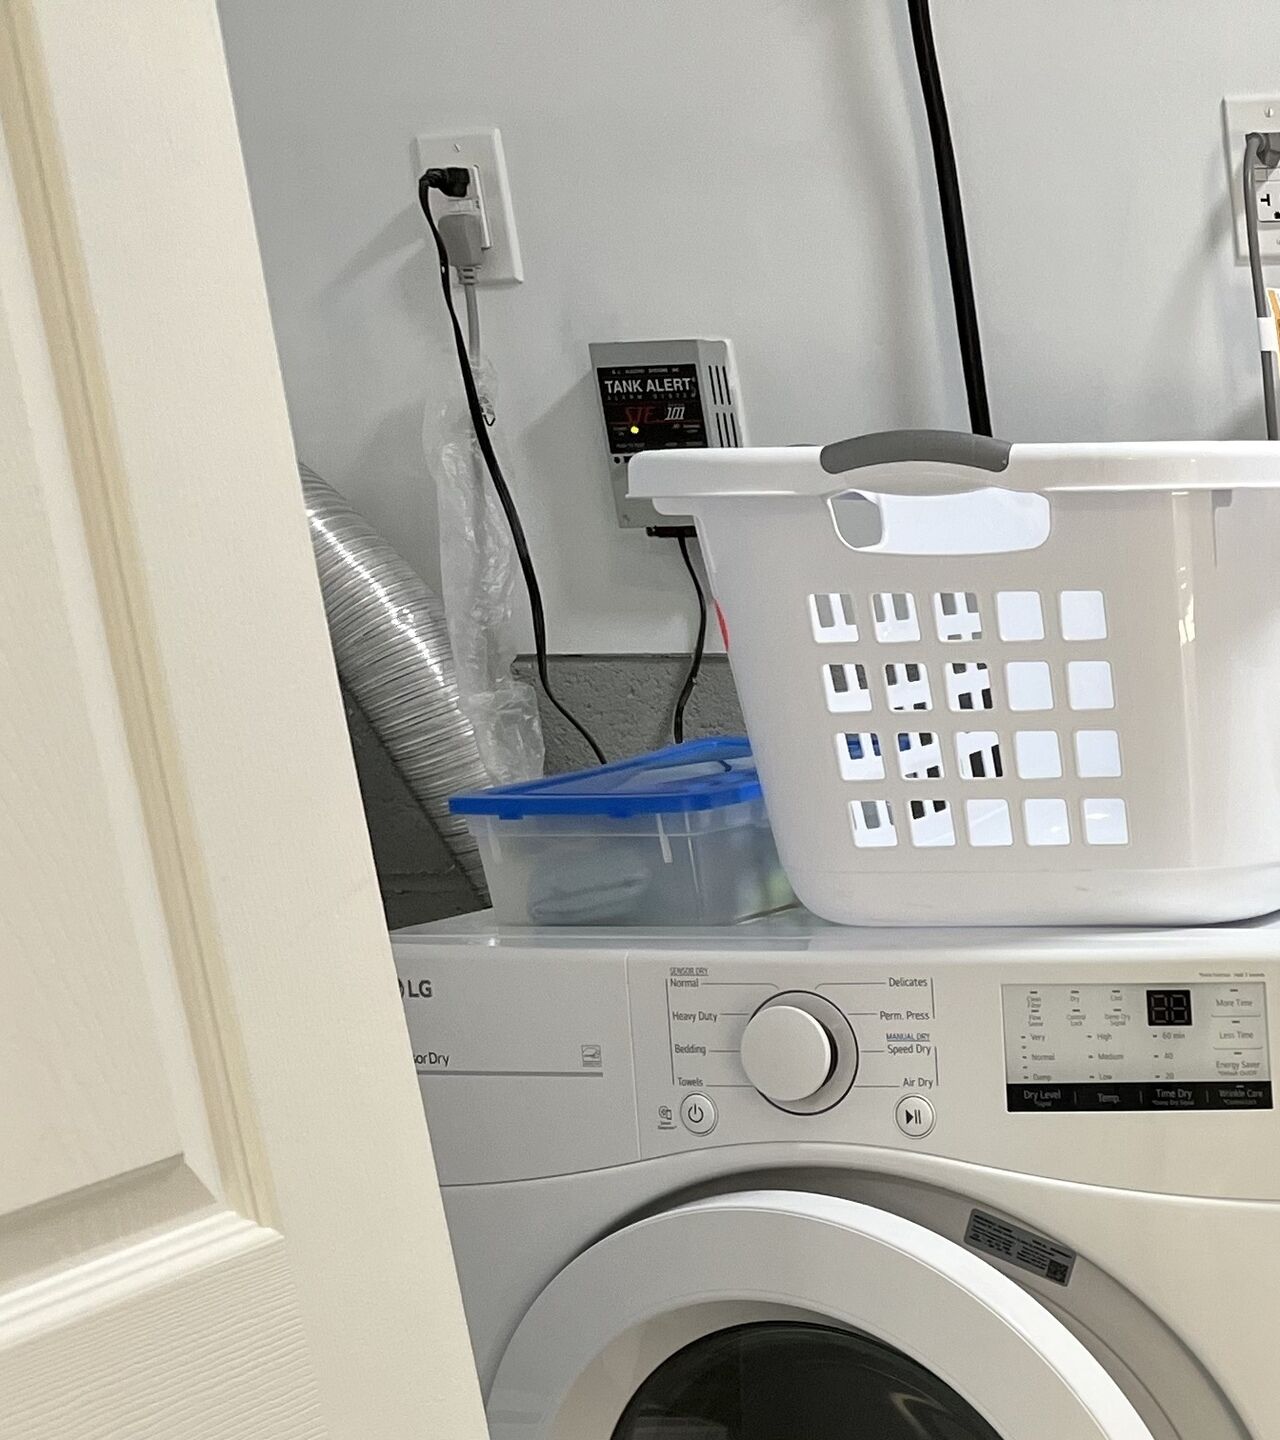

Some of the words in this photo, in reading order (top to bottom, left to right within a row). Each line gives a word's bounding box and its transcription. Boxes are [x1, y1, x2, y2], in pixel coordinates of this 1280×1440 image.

[604, 380, 643, 394] TANK
[646, 378, 691, 392] ALERT
[670, 978, 699, 988] Normal
[888, 977, 928, 987] Delicates
[408, 980, 433, 998] LG
[1216, 999, 1234, 1007] More
[1236, 998, 1253, 1007] Time
[672, 1011, 697, 1023] Heavy
[698, 1011, 718, 1023] Duty
[880, 1010, 904, 1021] Perm.
[906, 1010, 930, 1021] Press
[886, 1033, 915, 1041] MANUAL
[916, 1033, 931, 1041] DRY
[1162, 1032, 1172, 1040] 60
[1237, 1031, 1254, 1039] Time
[674, 1044, 707, 1056] Bedding
[887, 1044, 914, 1056] Speed
[915, 1043, 932, 1056] Dry
[1216, 1061, 1240, 1070] Energy
[1241, 1060, 1261, 1069] Saver
[678, 1076, 704, 1087] Towels
[903, 1077, 916, 1087] Air
[917, 1077, 933, 1090] Dry
[1023, 1090, 1038, 1101] Dry
[1040, 1088, 1061, 1100] Level
[1156, 1089, 1176, 1098] Time
[1177, 1089, 1193, 1100] Dry
